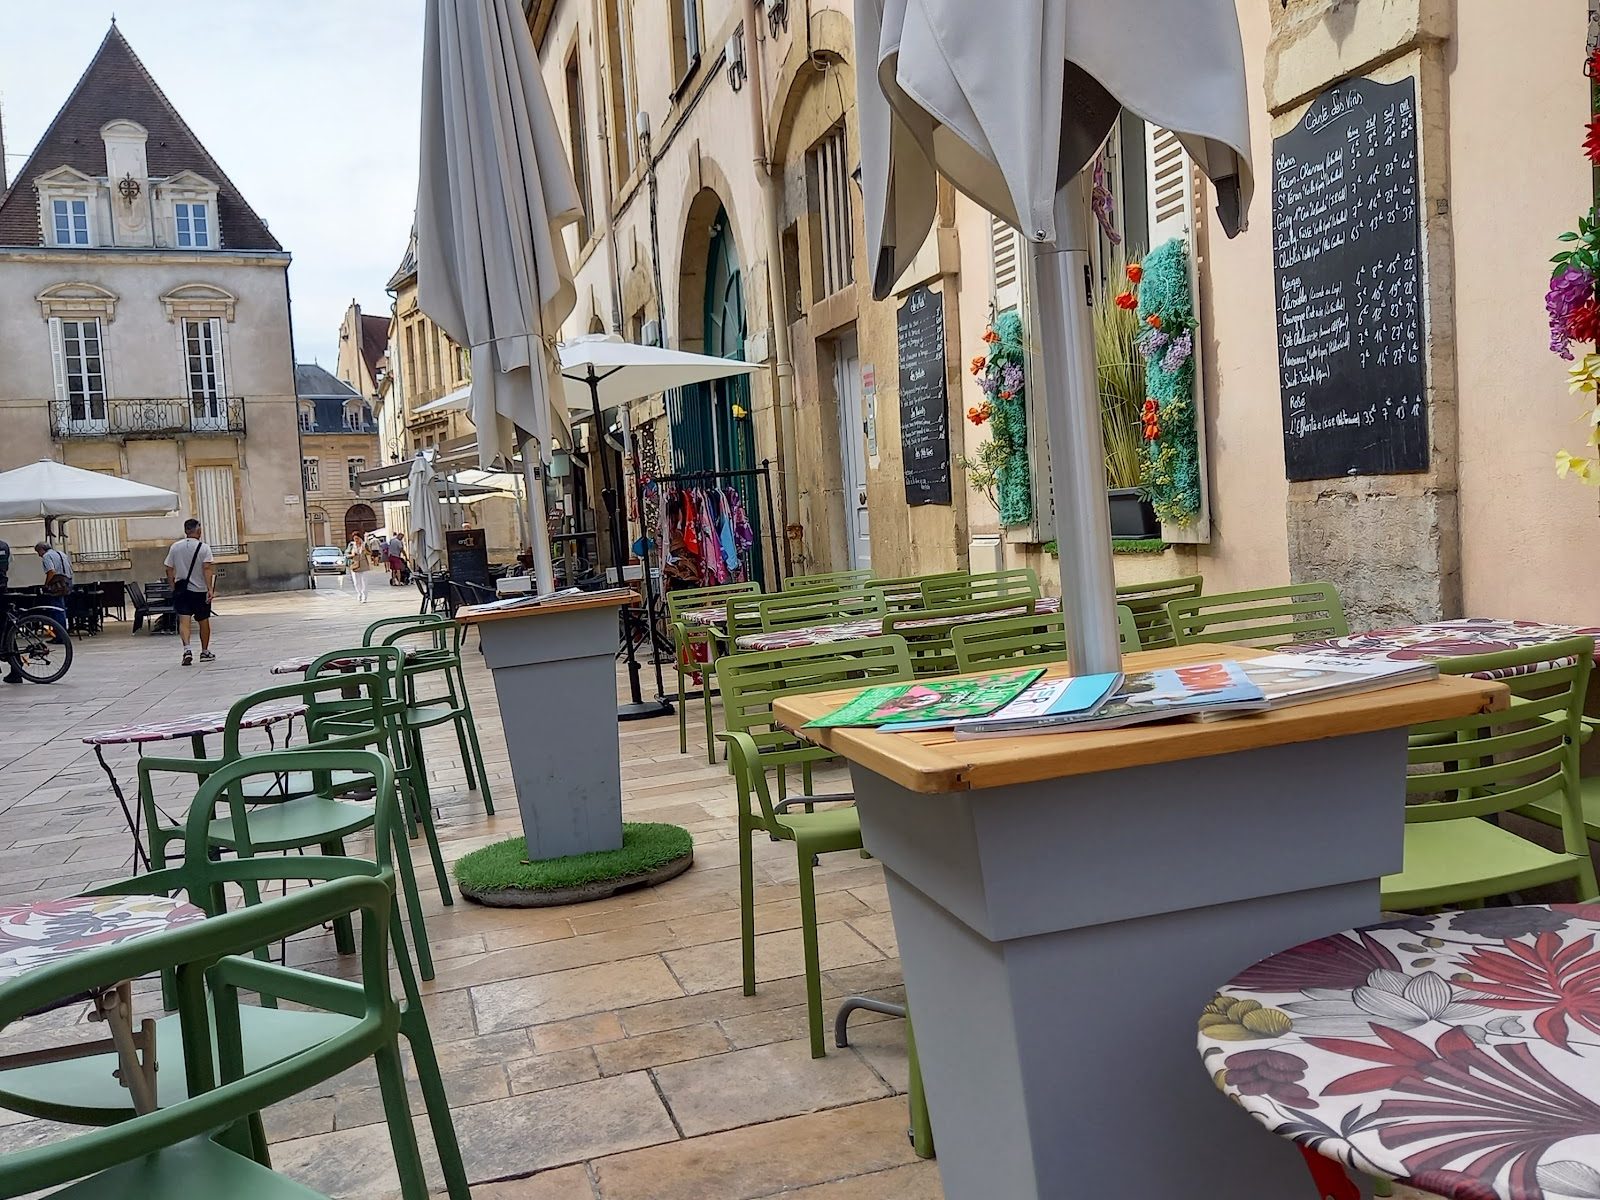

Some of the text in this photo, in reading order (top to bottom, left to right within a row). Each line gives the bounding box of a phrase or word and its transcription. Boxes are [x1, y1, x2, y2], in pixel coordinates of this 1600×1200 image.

[1304, 90, 1363, 130] Carte des Vins
[1289, 391, 1306, 409] Rosé
